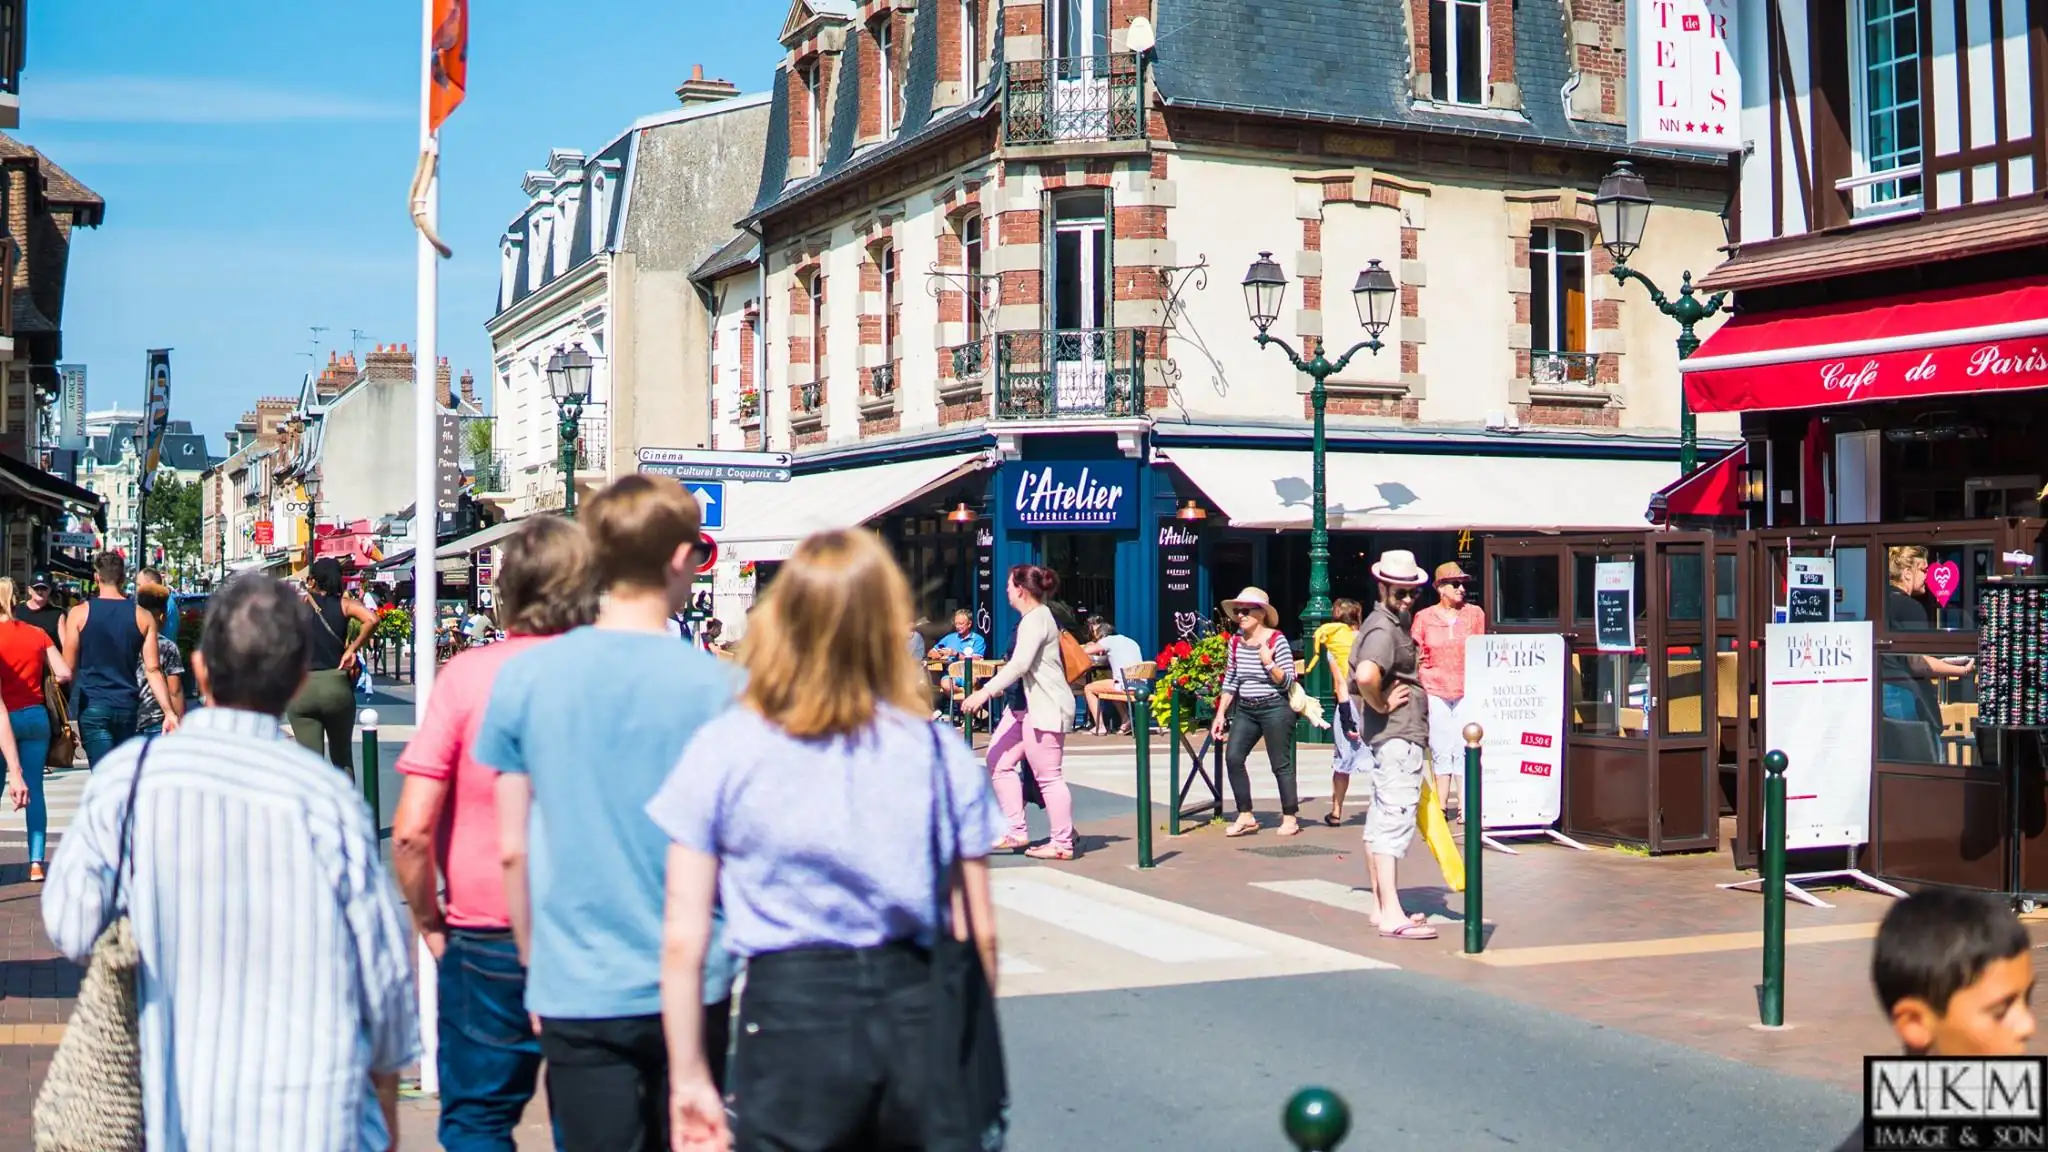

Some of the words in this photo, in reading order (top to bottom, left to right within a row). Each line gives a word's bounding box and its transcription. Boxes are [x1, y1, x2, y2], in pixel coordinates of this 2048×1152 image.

[1685, 18, 1698, 29] de
[1703, 0, 1728, 113] RIS
[1659, 118, 1680, 132] NN
[1820, 361, 1879, 400] Café
[1904, 353, 1936, 382] de
[1966, 345, 2048, 377] Paris
[68, 371, 76, 411] AGENCES
[443, 417, 453, 427] Le
[642, 450, 683, 461] Cinéma
[443, 474, 452, 482] et
[641, 464, 674, 476] Espace
[676, 465, 713, 477] Culturel
[715, 467, 724, 476] B.
[727, 468, 771, 480] Coquatrix
[1487, 650, 1546, 668] PARIS
[1787, 647, 1852, 668] PARIS
[1492, 684, 1537, 696] MOULES
[1500, 708, 1537, 720] FRITES
